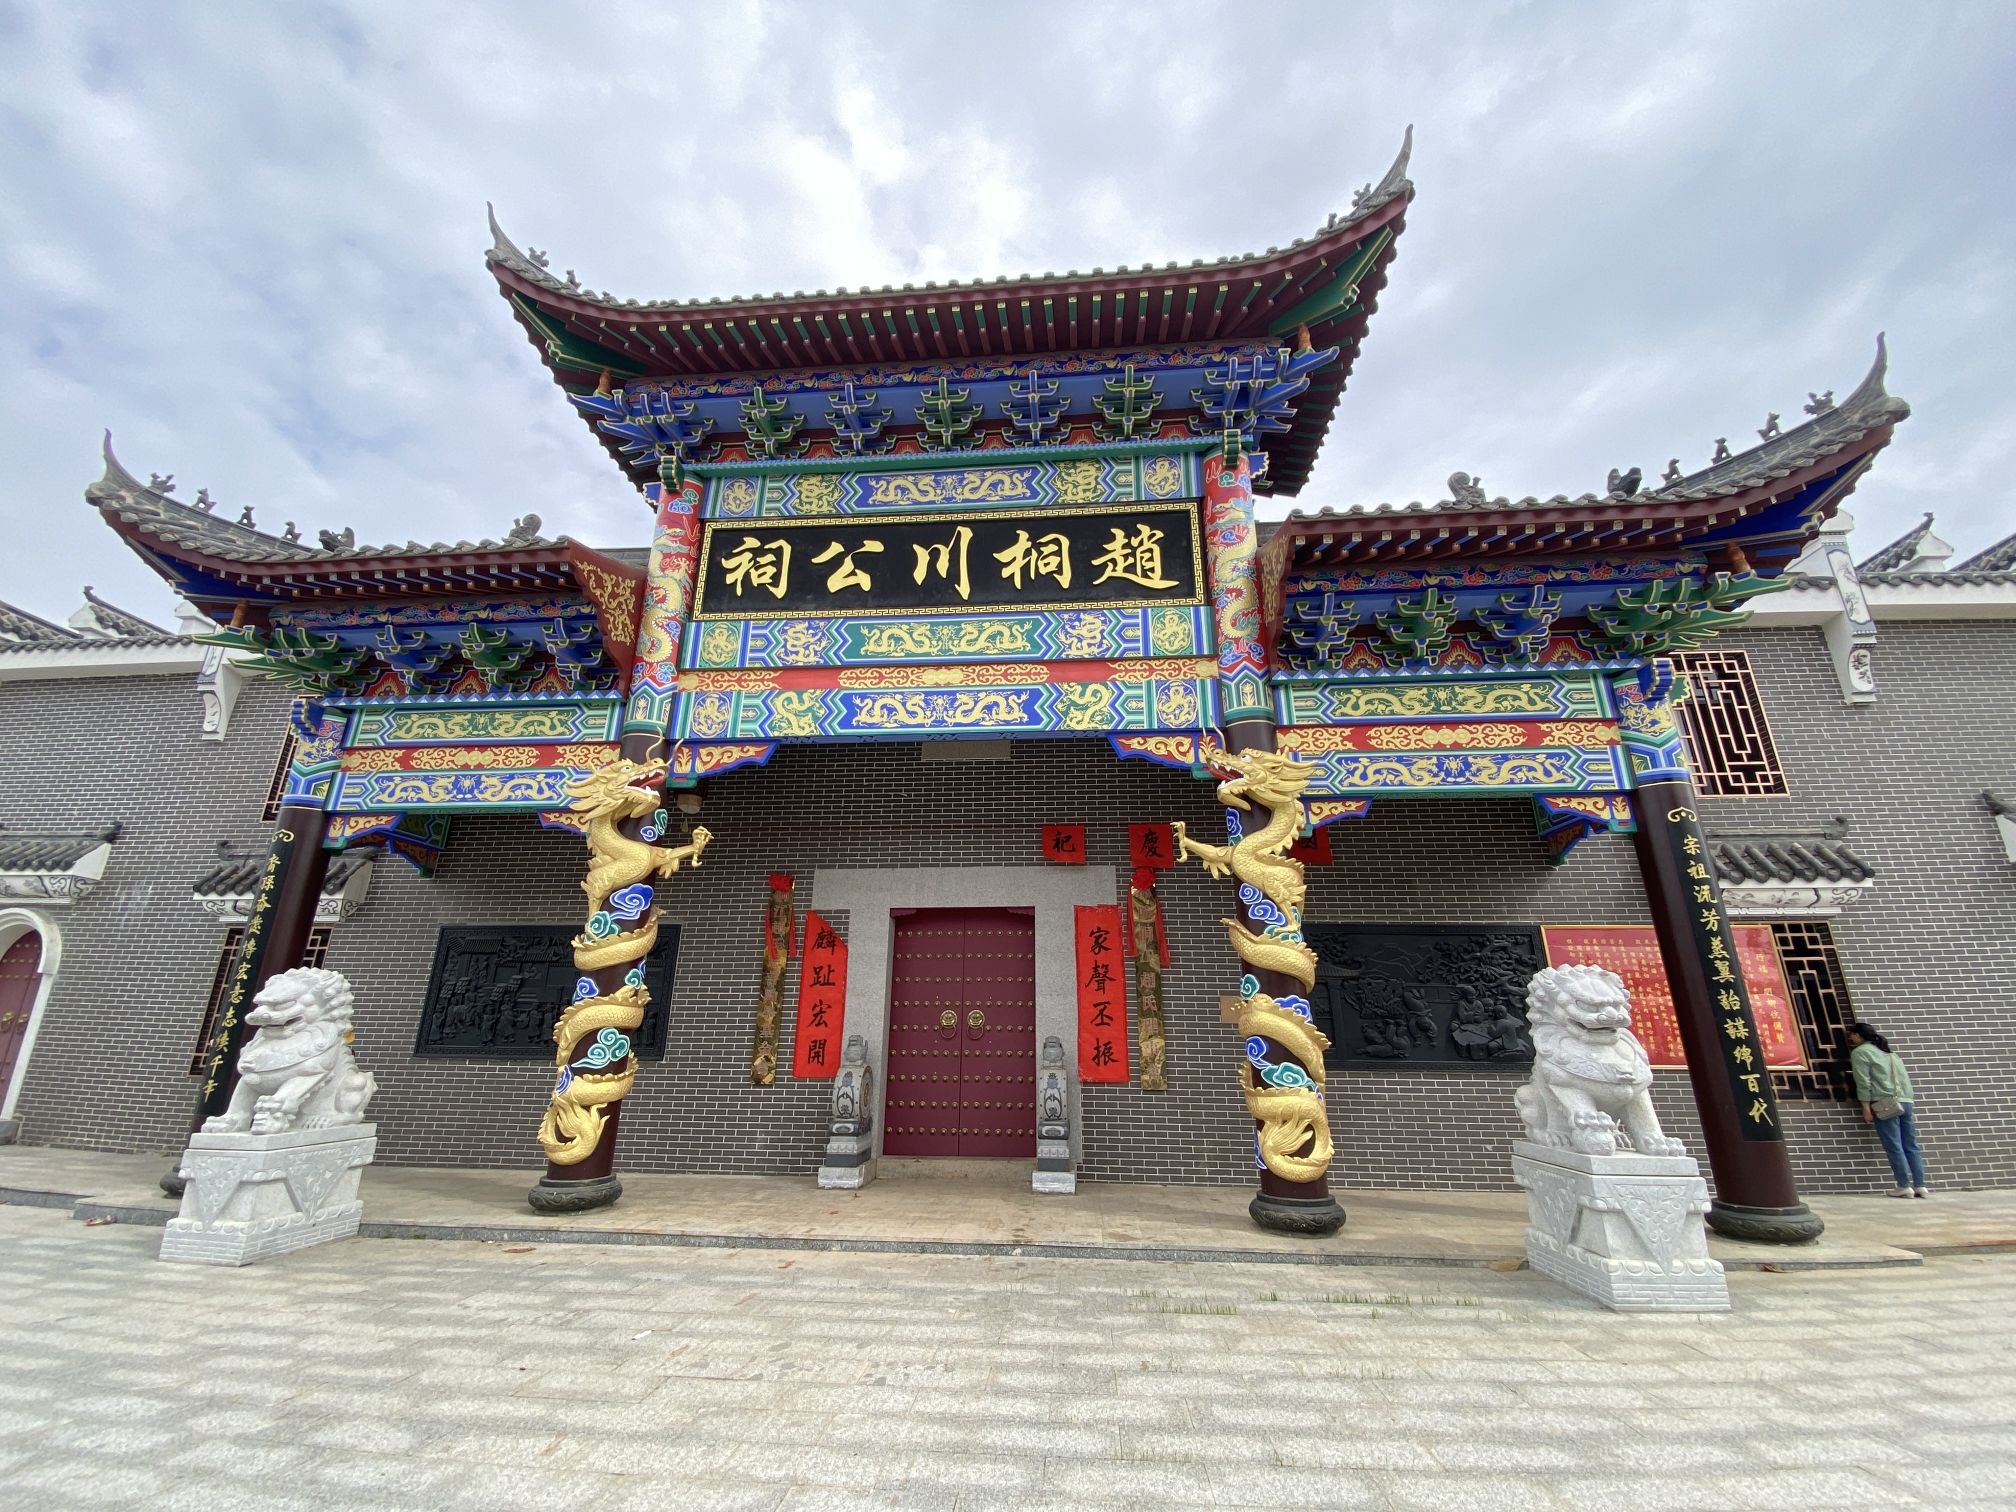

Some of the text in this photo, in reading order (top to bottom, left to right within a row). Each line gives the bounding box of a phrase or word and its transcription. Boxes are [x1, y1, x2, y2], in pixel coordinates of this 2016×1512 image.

[721, 525, 1180, 600] 趙桐川公祠
[1140, 828, 1163, 858] 慶
[807, 926, 837, 1066] 麟趾宏開
[1085, 926, 1120, 1067] 家聲丕振
